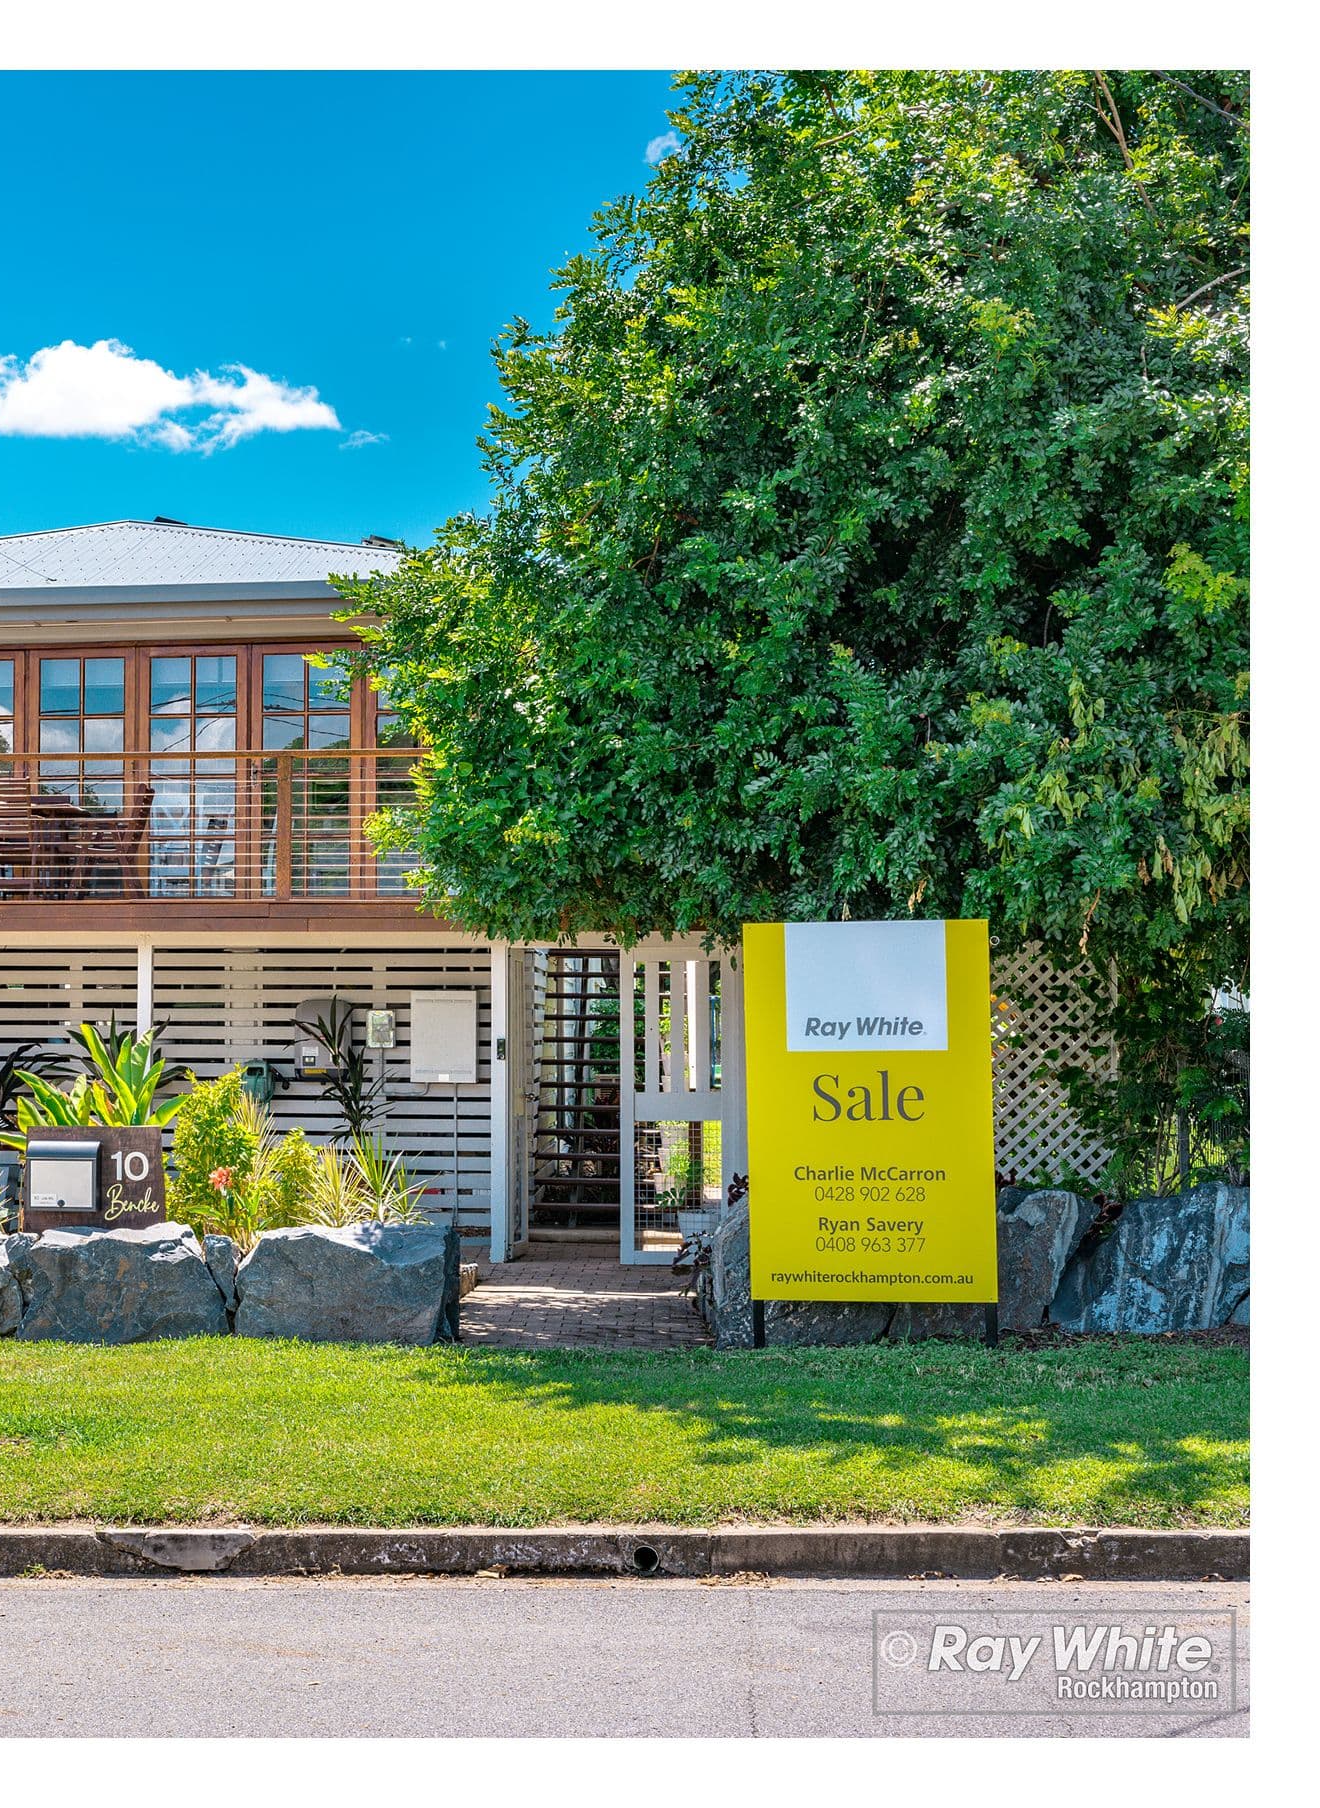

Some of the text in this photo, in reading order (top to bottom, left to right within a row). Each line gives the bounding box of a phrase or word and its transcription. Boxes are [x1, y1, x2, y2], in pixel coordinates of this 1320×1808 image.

[804, 1016, 924, 1041] Ray White
[812, 1070, 926, 1122] Sale
[111, 1151, 149, 1181] 10
[793, 1165, 946, 1182] Charlie McCarron
[104, 1183, 160, 1221] Bencke
[814, 1186, 926, 1202] 0428 902 628
[818, 1216, 924, 1235] Ryan Savery
[815, 1237, 926, 1253] 0408 963 377
[771, 1269, 974, 1288] raywhiterockhampton.com.au
